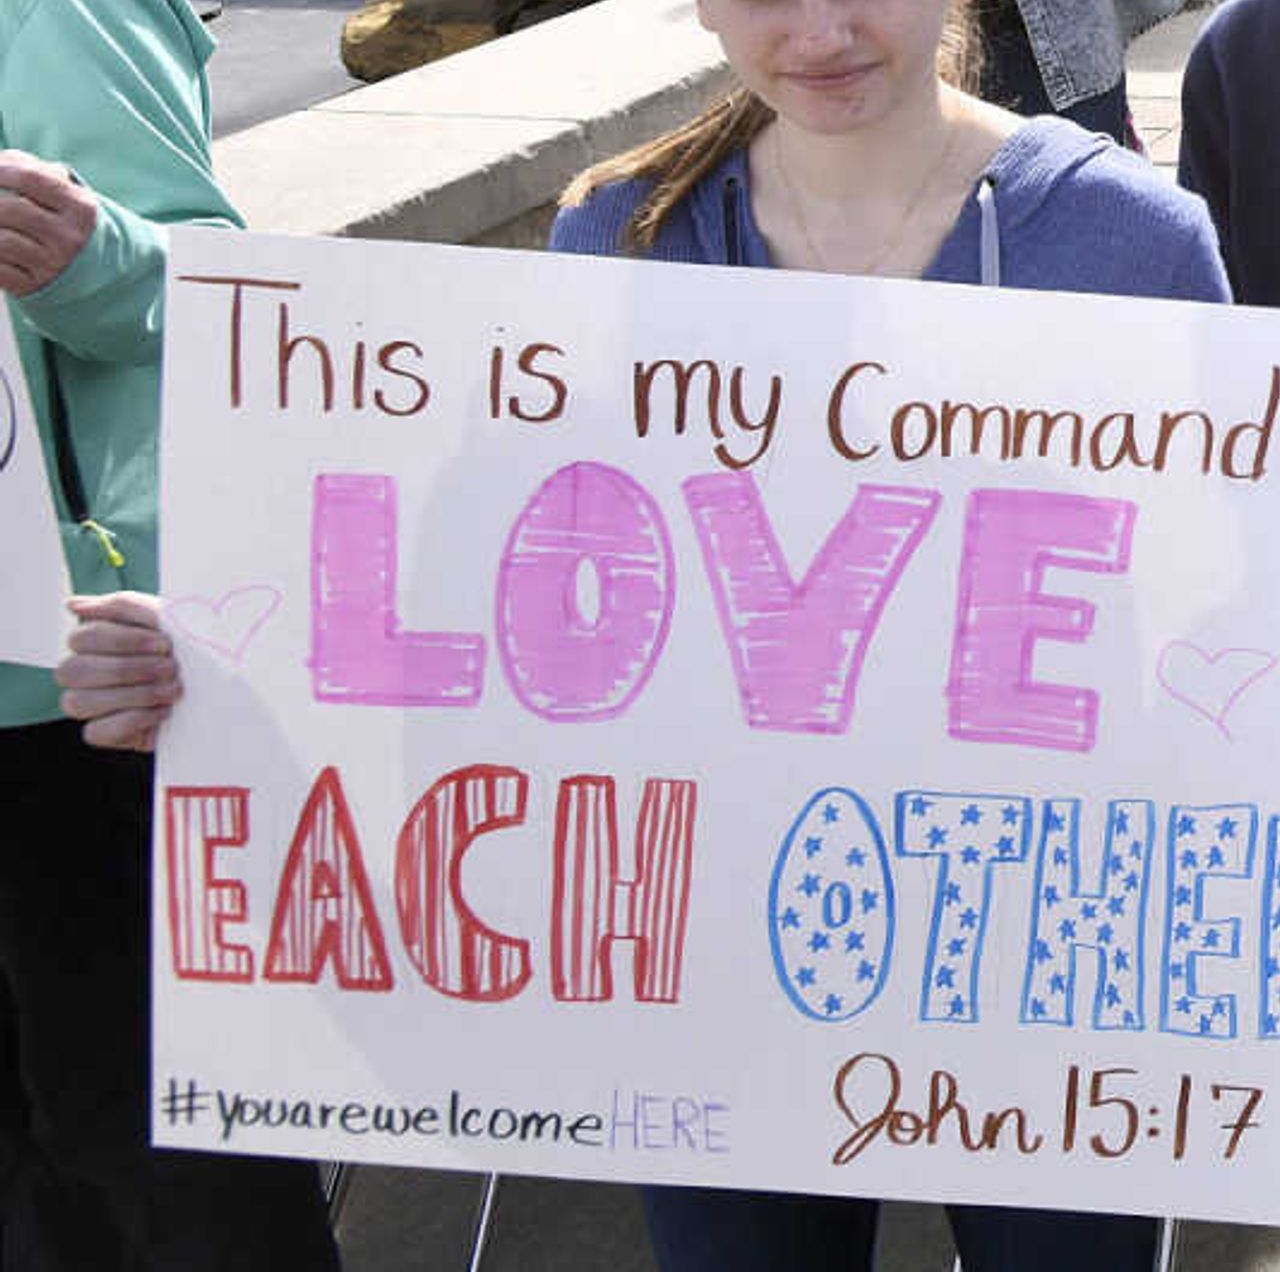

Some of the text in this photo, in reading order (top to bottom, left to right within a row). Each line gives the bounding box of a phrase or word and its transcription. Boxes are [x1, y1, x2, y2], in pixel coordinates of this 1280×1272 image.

[176, 275, 431, 417] This
[489, 327, 568, 422] is
[633, 358, 782, 470] my
[308, 461, 1138, 753] LOVE
[166, 763, 697, 1004] EACH
[833, 1052, 1264, 1165] John 15:17
